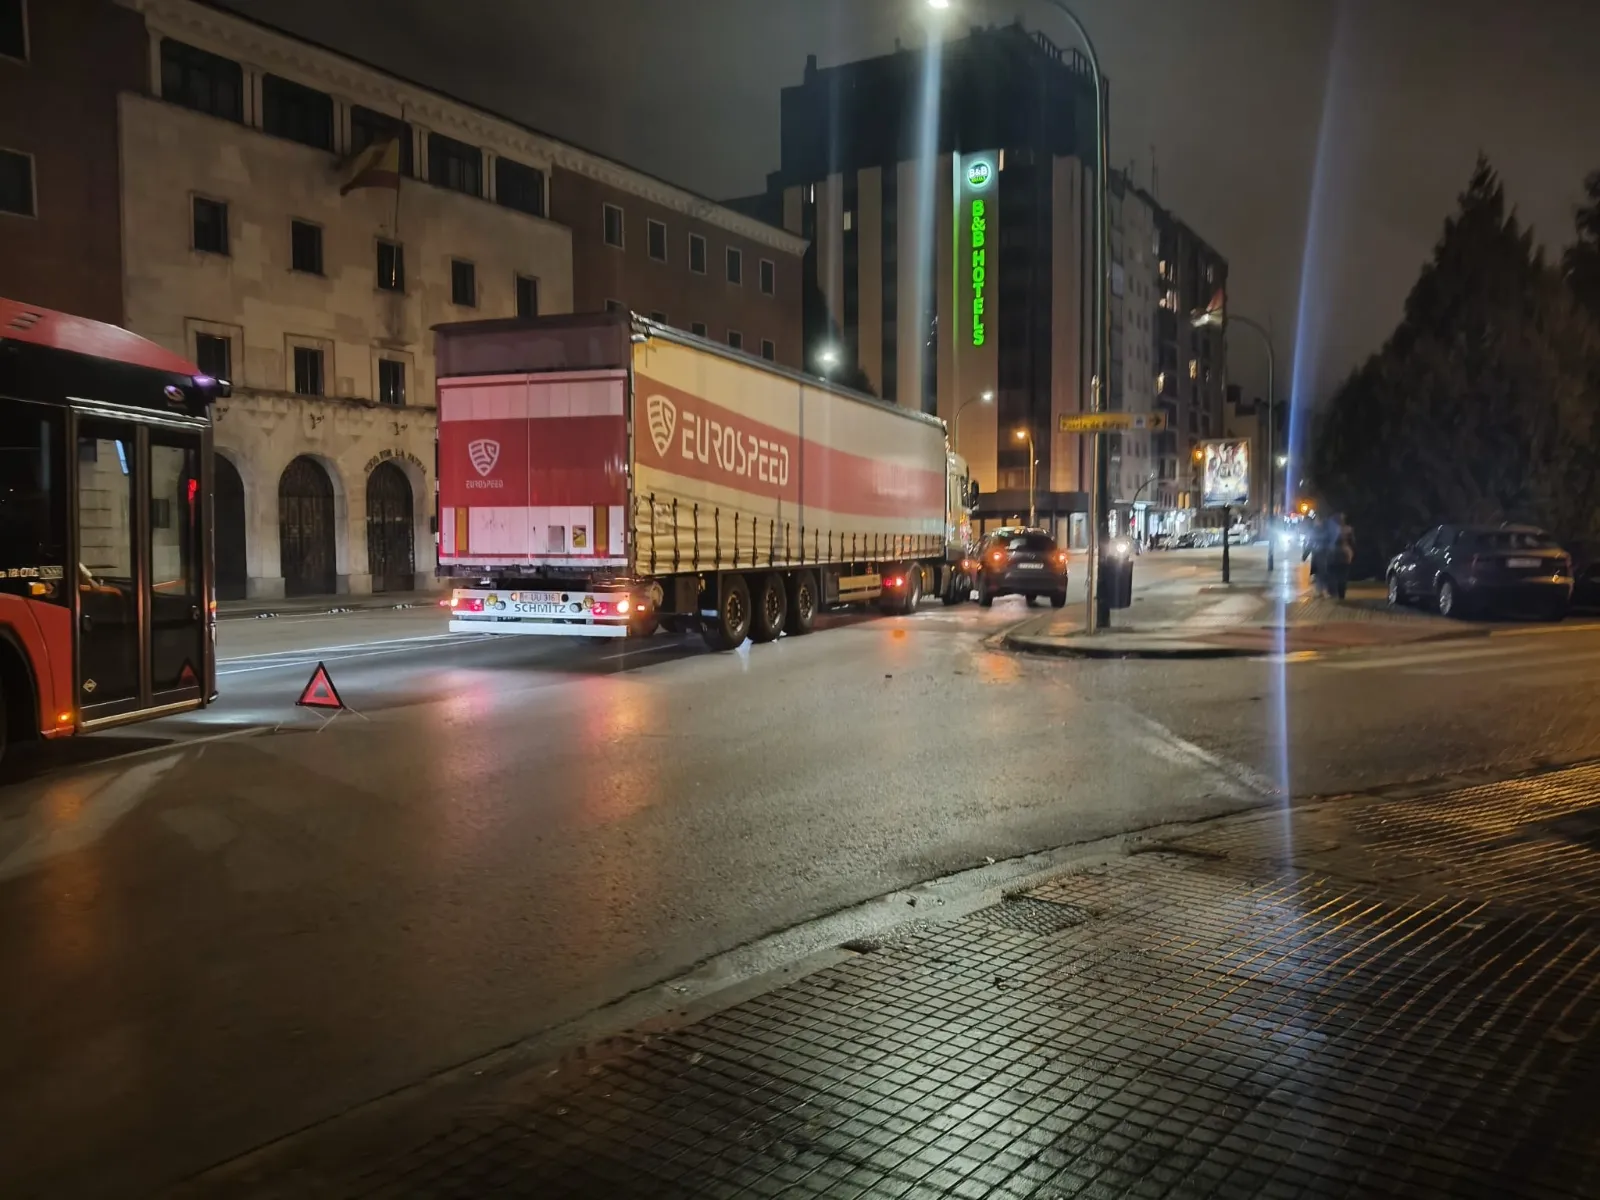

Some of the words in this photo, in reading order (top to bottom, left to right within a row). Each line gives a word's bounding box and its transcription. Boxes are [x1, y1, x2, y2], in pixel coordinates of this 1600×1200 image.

[969, 165, 987, 177] B&B
[971, 200, 985, 247] B&B
[972, 249, 985, 345] HOTELS
[681, 411, 789, 486] EUROSPEED
[465, 479, 504, 489] EUROSPEED
[514, 603, 566, 614] SCHMITZ
